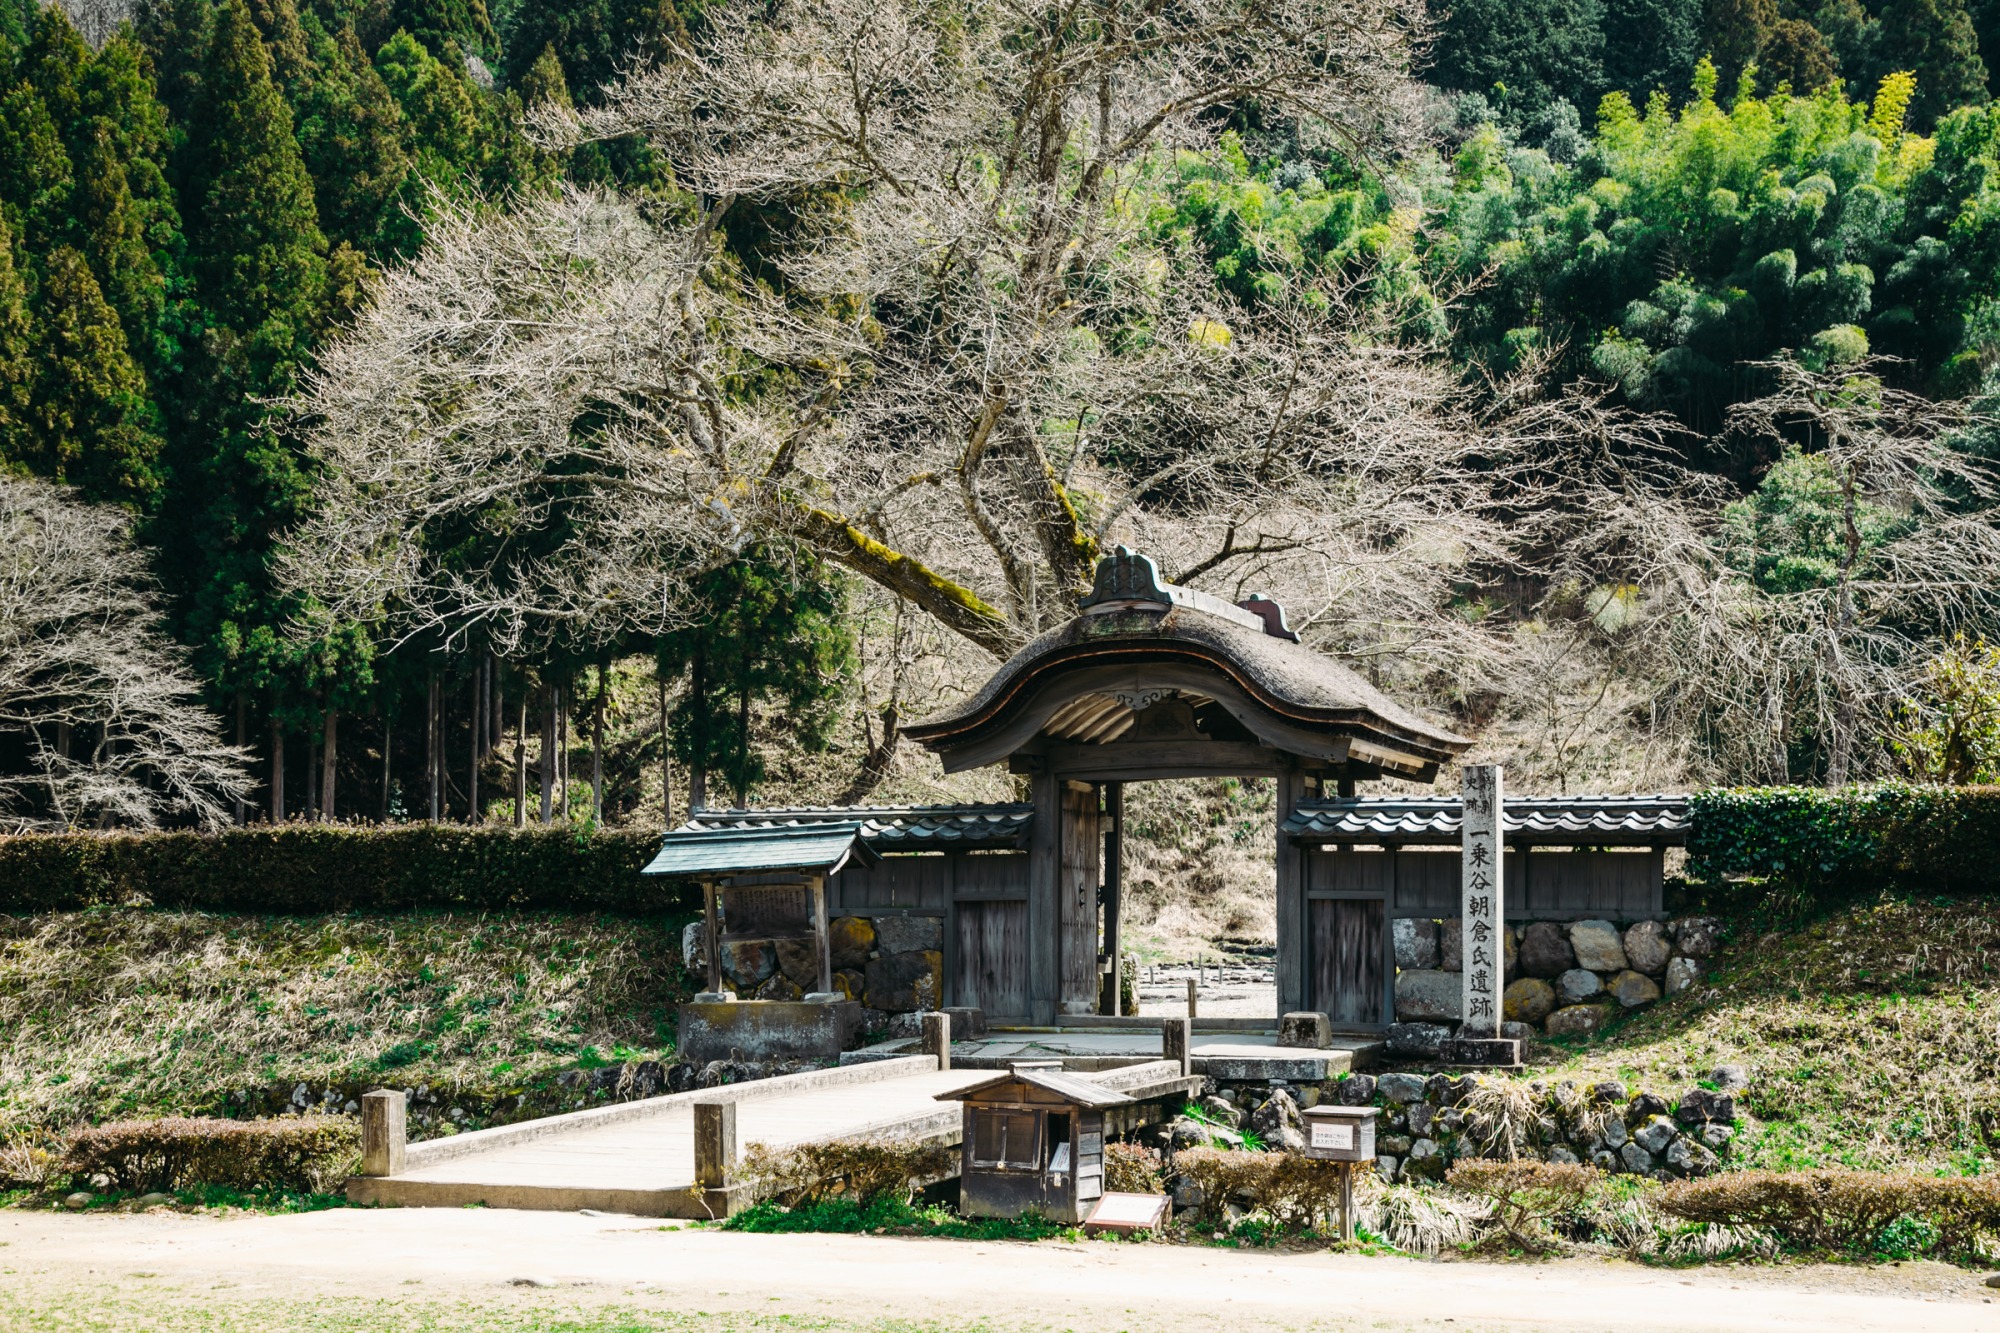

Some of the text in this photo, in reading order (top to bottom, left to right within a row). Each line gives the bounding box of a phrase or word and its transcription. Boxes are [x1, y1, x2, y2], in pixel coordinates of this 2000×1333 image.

[1468, 830, 1494, 1018] 一乗谷朝倉氏遺跡
